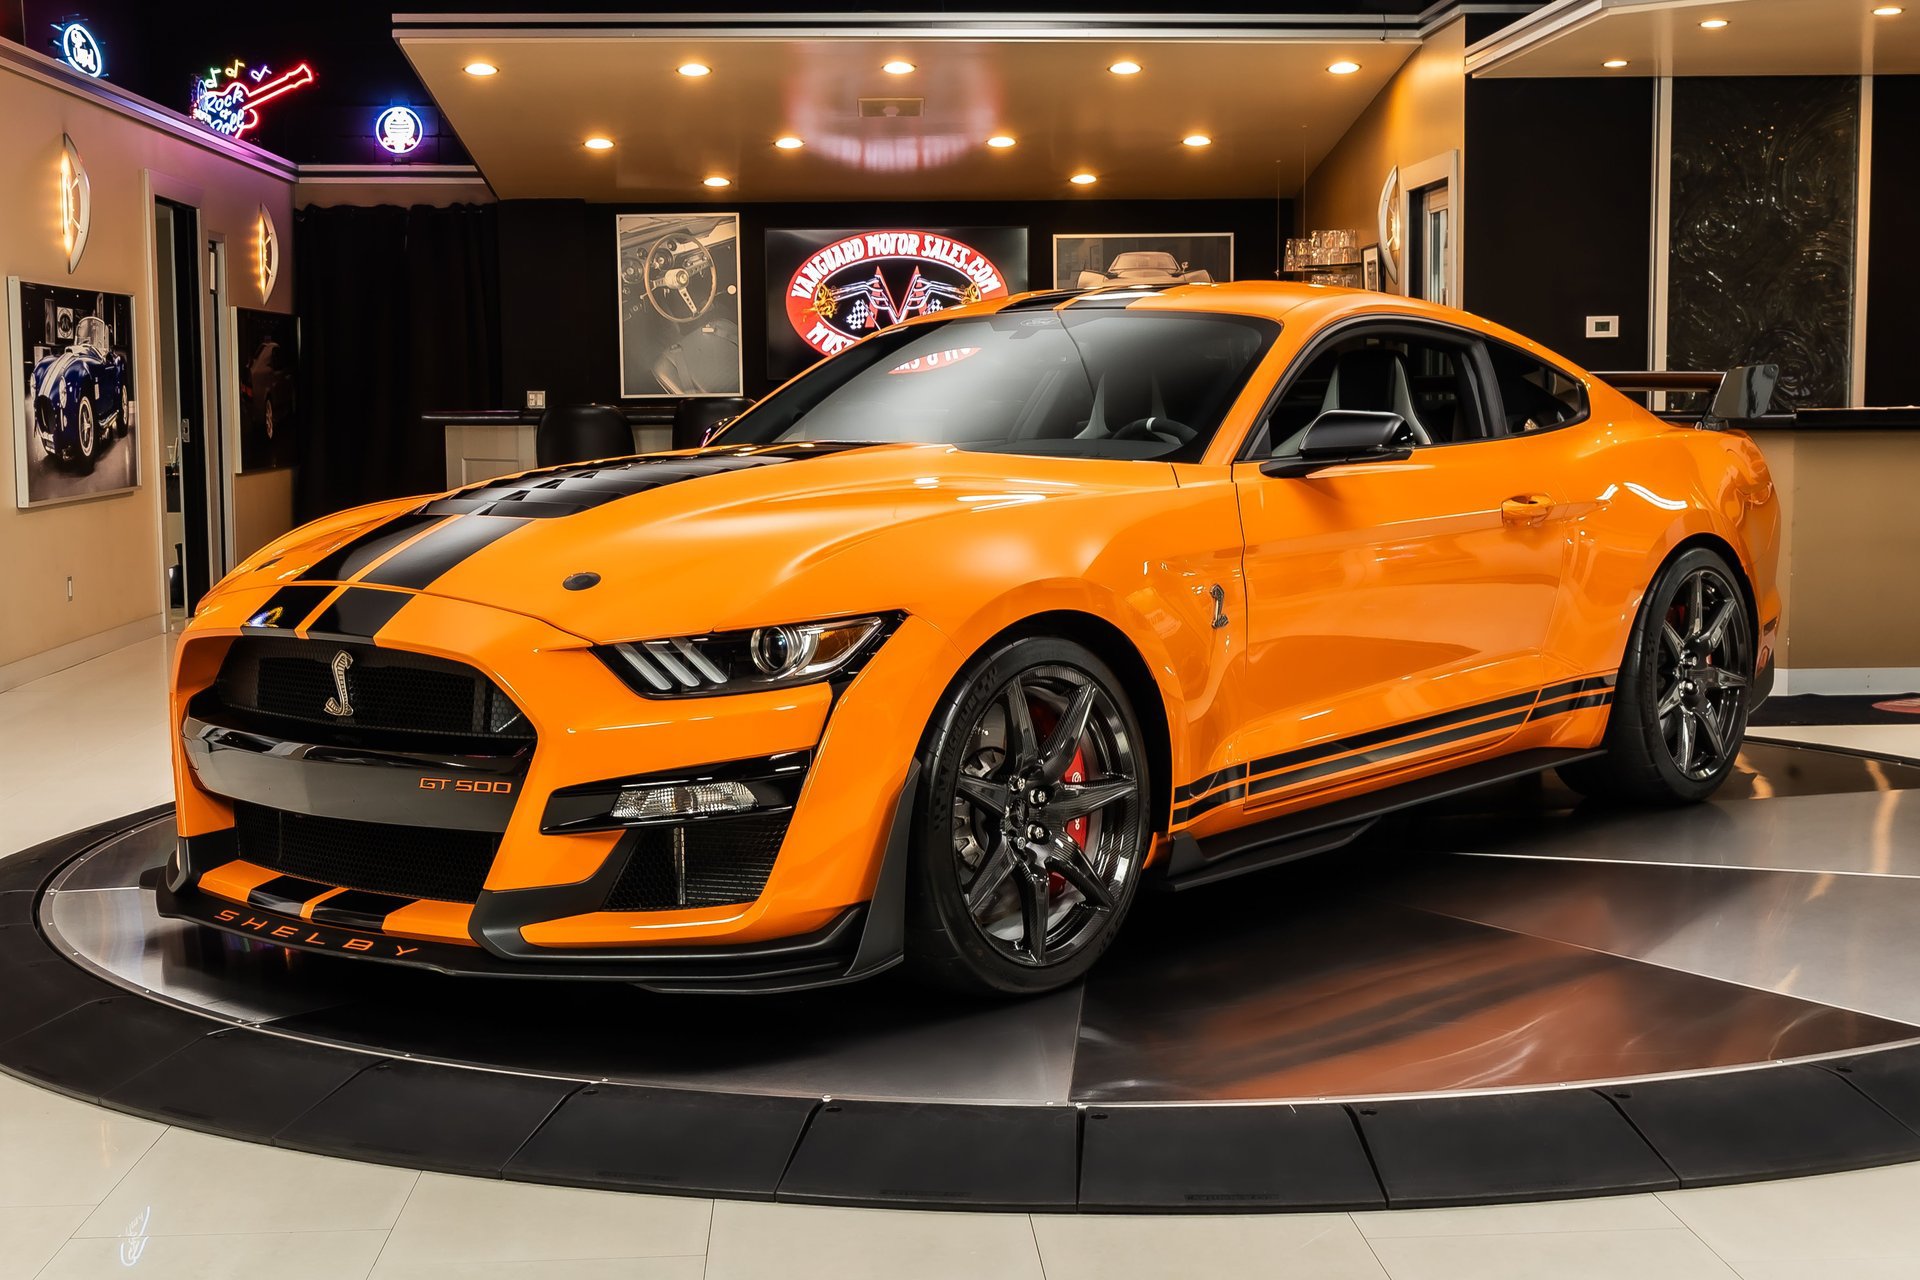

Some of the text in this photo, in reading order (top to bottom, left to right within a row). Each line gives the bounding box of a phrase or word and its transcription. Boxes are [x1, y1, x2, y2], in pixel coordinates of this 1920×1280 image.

[202, 84, 244, 113] Rock
[791, 232, 1002, 300] VANGUARD MOTOR SALES.COM
[806, 321, 856, 355] MUS
[419, 777, 512, 794] GT 500
[215, 908, 419, 957] SHELBY
